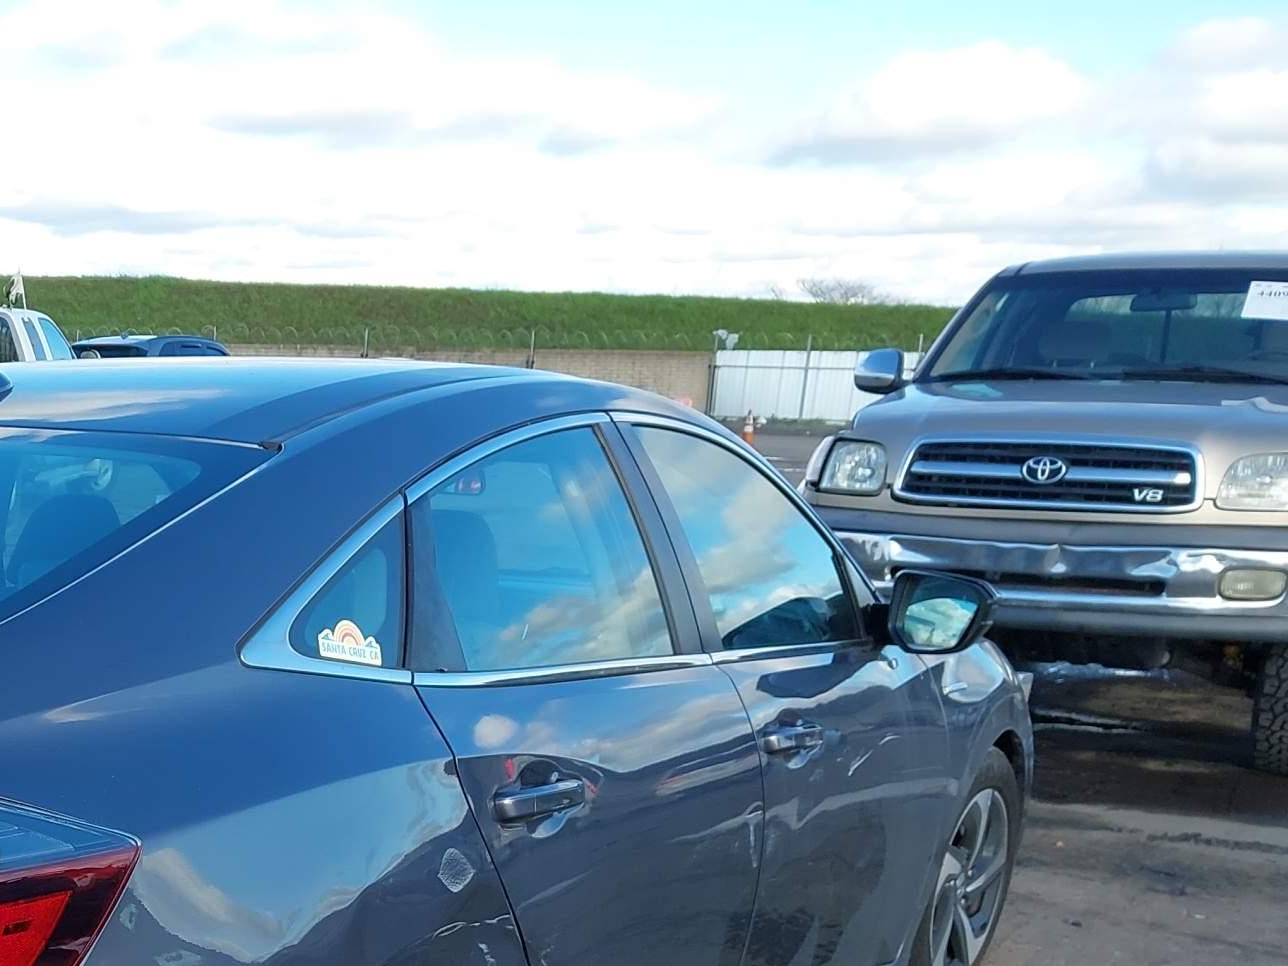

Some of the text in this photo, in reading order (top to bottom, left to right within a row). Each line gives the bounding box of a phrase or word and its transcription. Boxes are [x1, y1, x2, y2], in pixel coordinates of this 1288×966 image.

[1133, 488, 1164, 503] V8
[322, 641, 380, 661] SANTA CRUZ CA
